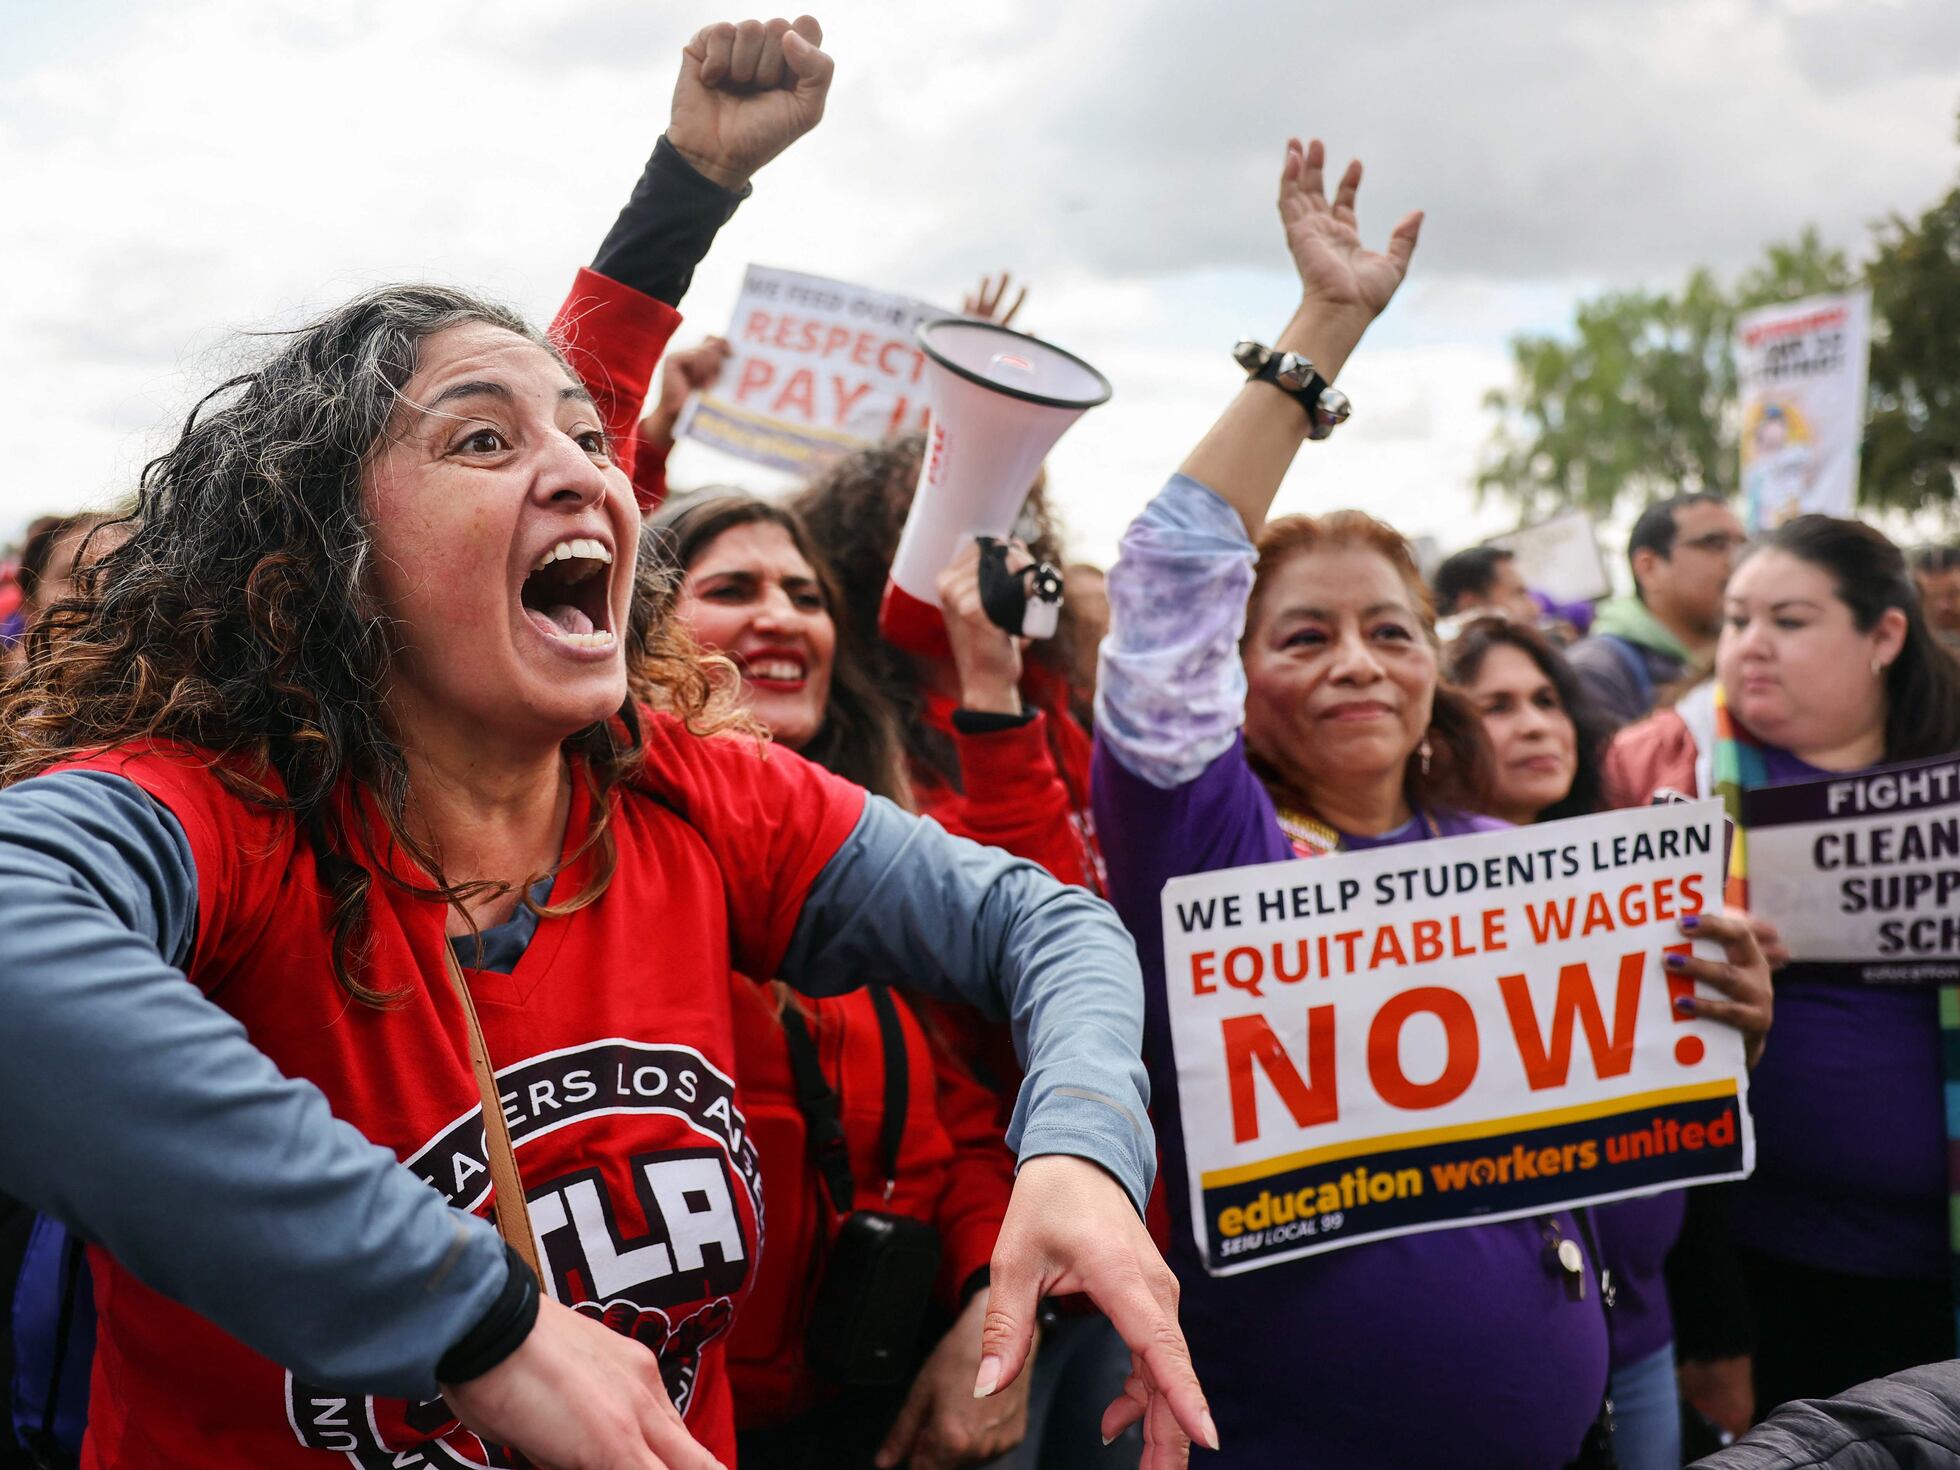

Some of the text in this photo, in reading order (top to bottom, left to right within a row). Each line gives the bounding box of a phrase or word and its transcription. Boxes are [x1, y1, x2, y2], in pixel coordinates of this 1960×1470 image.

[743, 309, 926, 385] RESPECT
[734, 356, 873, 427] PAY
[1827, 764, 1960, 815] FIGHT
[1177, 823, 1712, 933] WE HELP STUDENTS LEARN
[1814, 818, 1960, 871] CLEAN
[1190, 874, 1704, 997] EQUITABLE WAGES
[1221, 942, 1705, 1145] NOW!
[617, 1063, 698, 1104] LOS
[1218, 1108, 1735, 1238] education workers united
[526, 1157, 745, 1300] TLA
[1220, 1212, 1344, 1257] SEIU LOCAL 99
